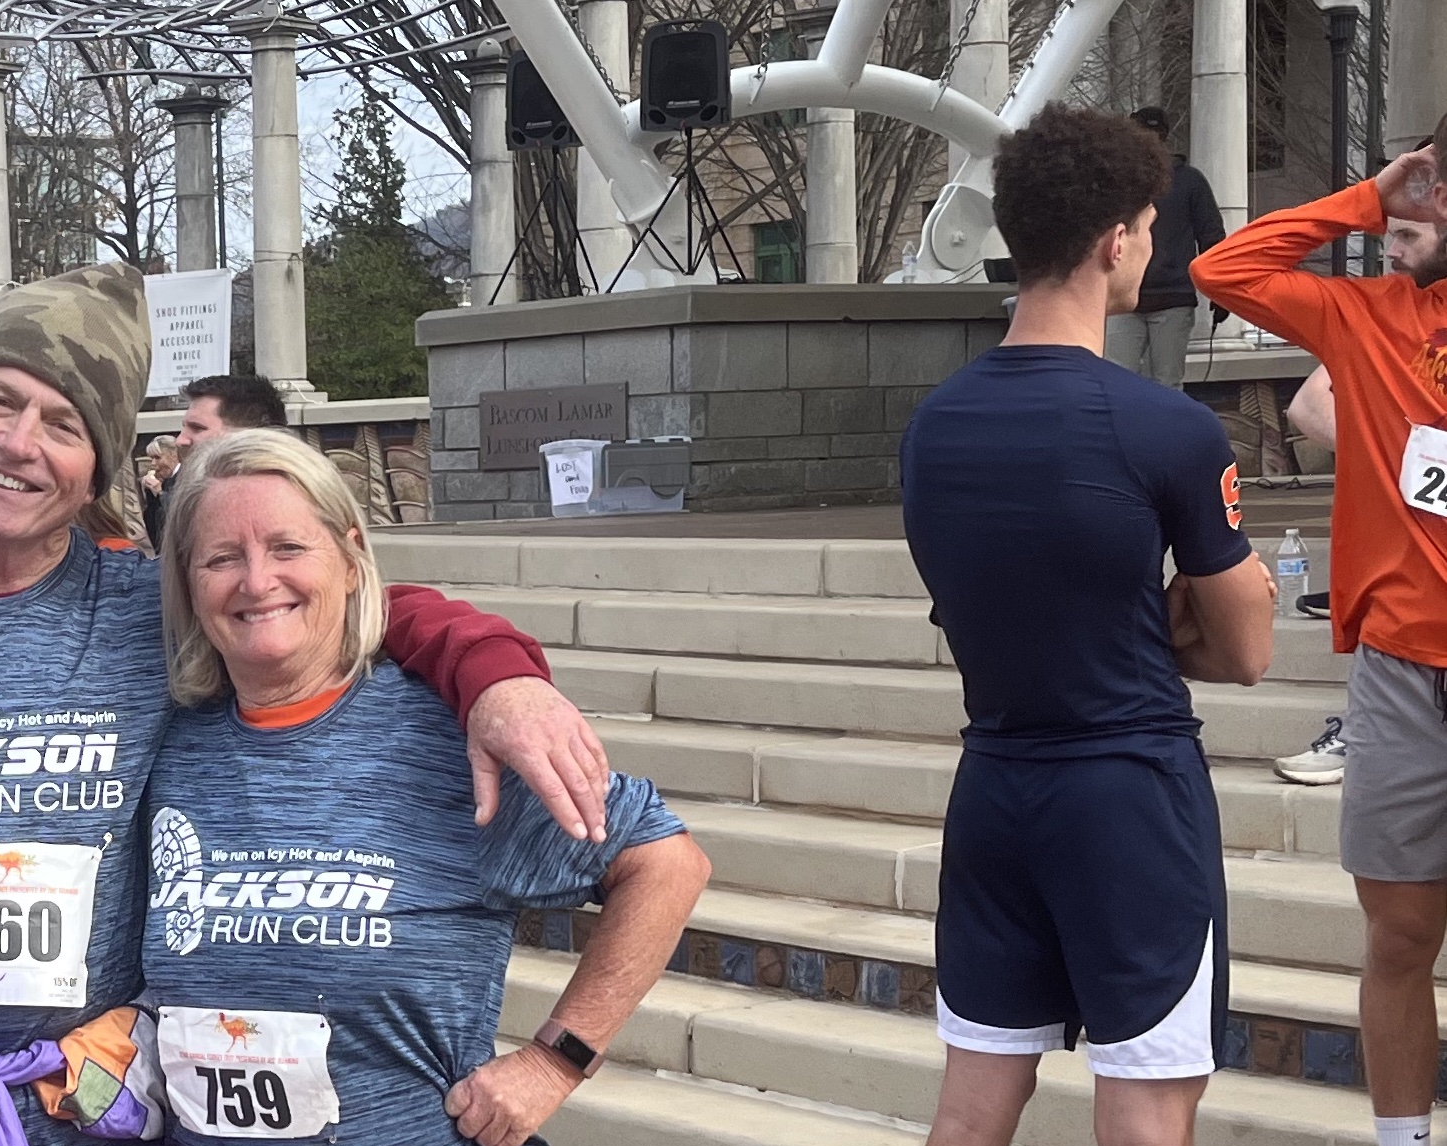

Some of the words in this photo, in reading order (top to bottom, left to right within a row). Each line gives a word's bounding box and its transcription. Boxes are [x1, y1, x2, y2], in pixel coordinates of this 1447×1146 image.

[156, 306, 177, 318] SHOE
[180, 303, 217, 316] FITTINGS
[170, 320, 204, 331] APPAREL
[160, 334, 214, 347] ACCESSORIES
[556, 460, 576, 473] LOST
[18, 713, 42, 727] Hot
[45, 711, 70, 725] and
[72, 710, 117, 728] Aspirin
[33, 779, 124, 812] CLUB
[211, 848, 228, 862] We
[230, 850, 247, 862] run
[250, 850, 265, 862] on
[267, 847, 286, 864] Icy
[289, 848, 313, 861] Hot
[316, 850, 342, 862] and
[344, 849, 396, 869] Aspirin
[150, 870, 395, 911] JACKSON
[210, 915, 283, 945] RUN
[292, 915, 393, 948] CLUB
[195, 1065, 292, 1130] 759
